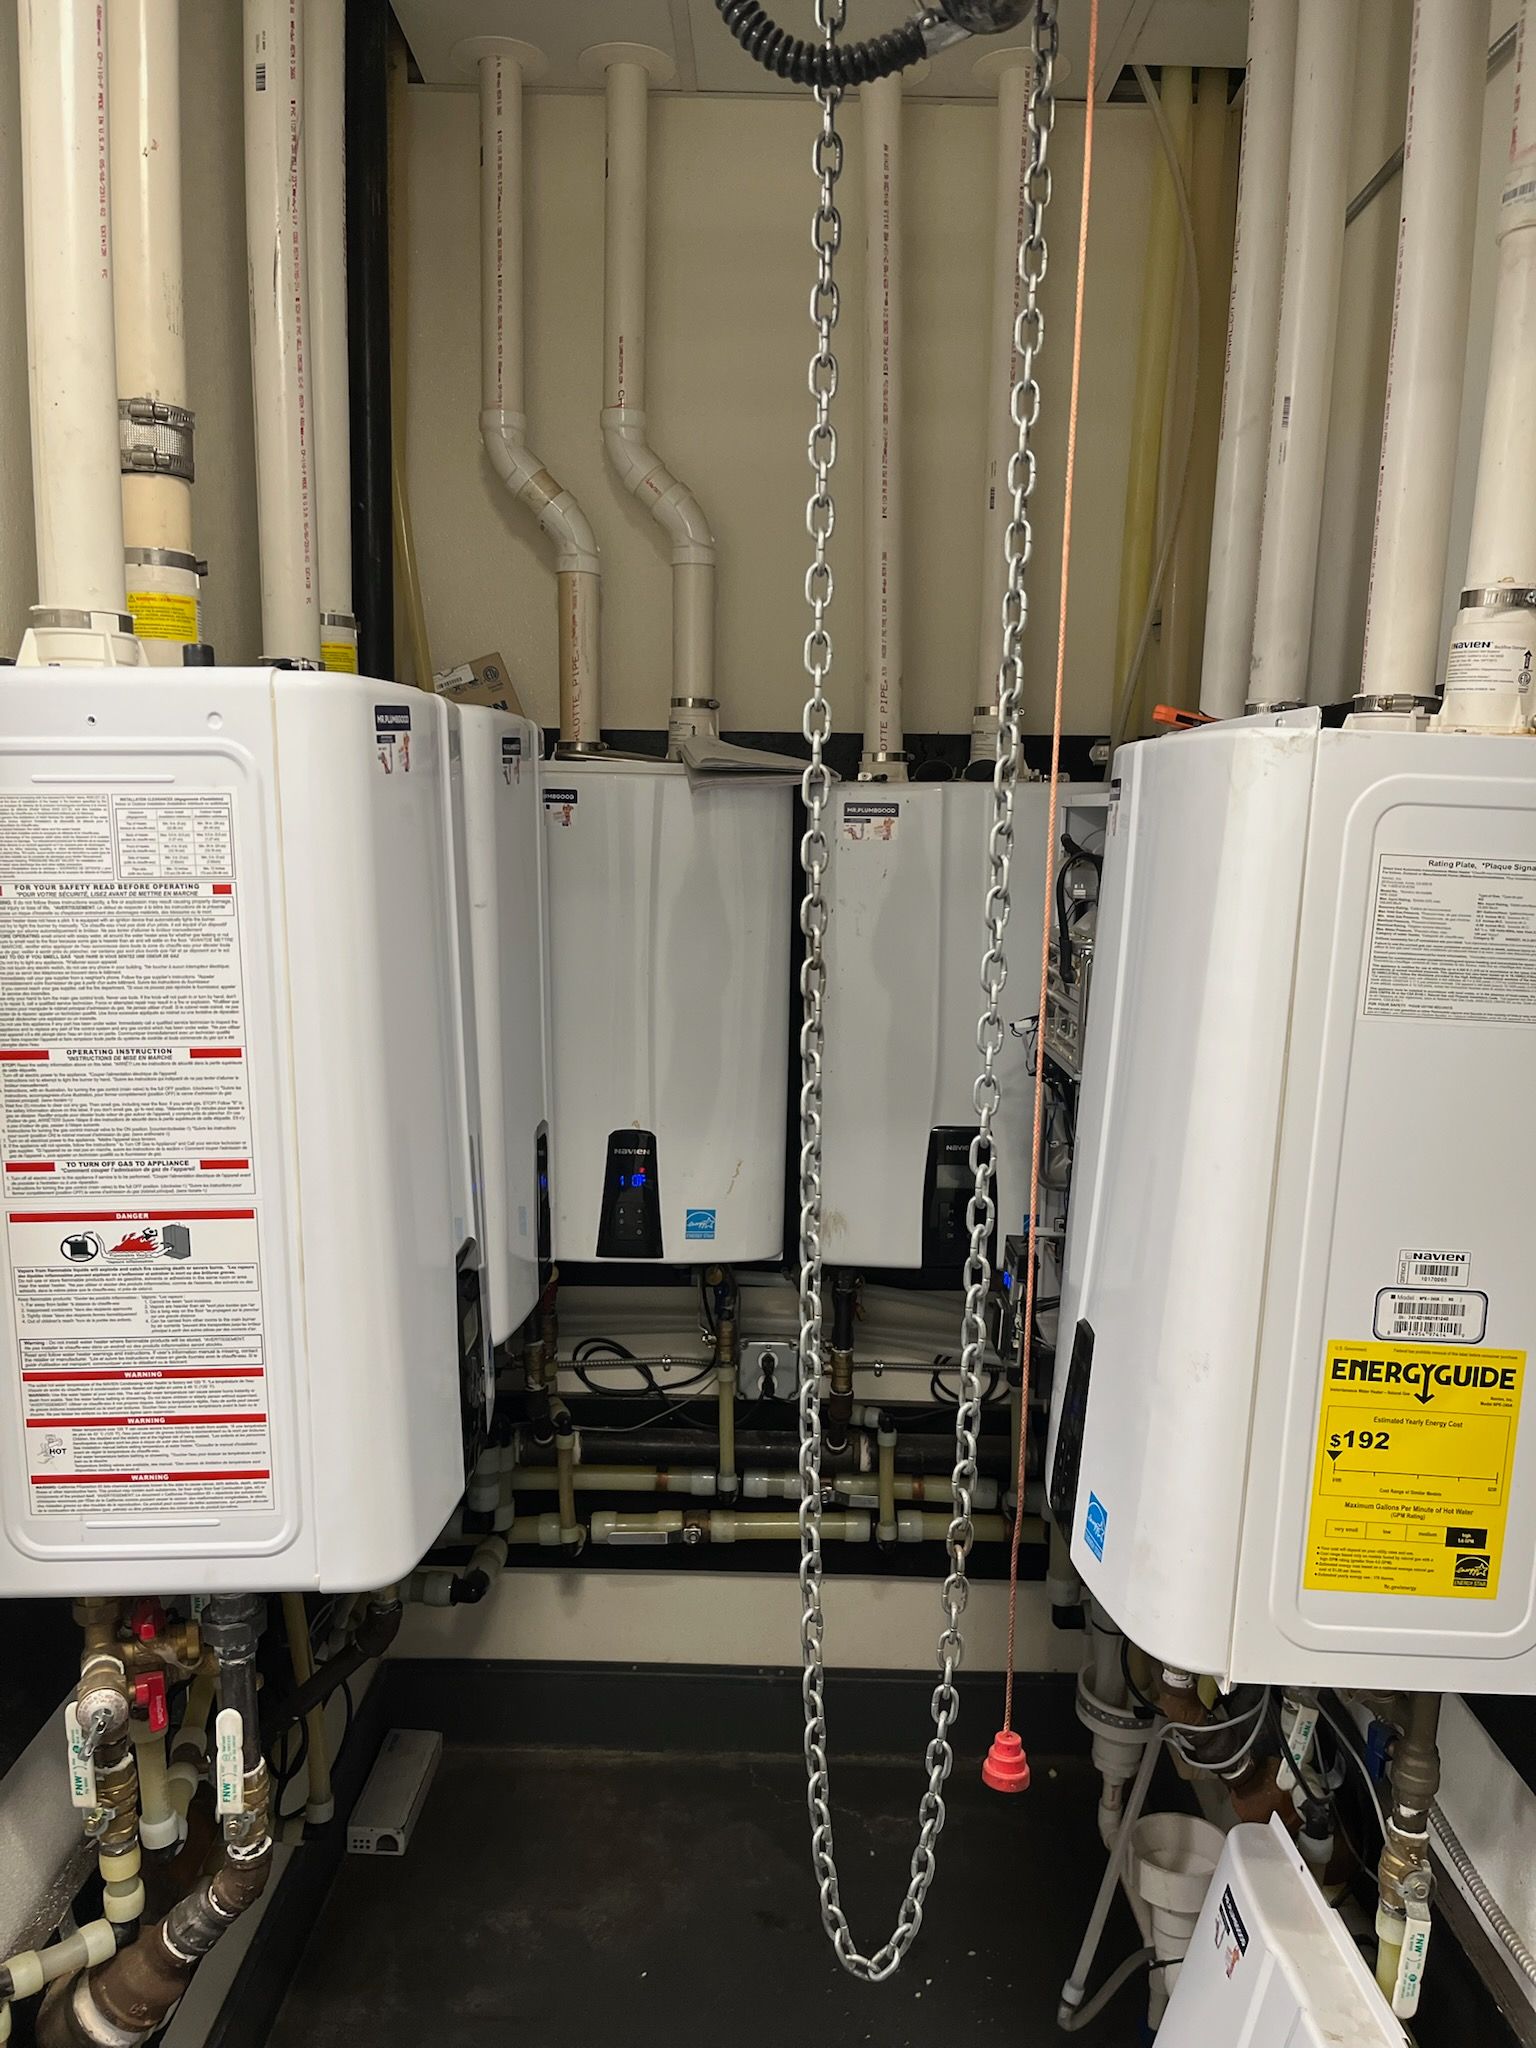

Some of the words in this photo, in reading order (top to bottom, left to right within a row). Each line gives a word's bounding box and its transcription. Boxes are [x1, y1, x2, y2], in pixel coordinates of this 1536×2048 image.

[572, 655, 580, 687] PIPE
[880, 680, 888, 714] PIPE
[1428, 860, 1454, 869] Rating
[1455, 861, 1477, 870] Plate,
[124, 1370, 163, 1379] WARNING
[1331, 1358, 1517, 1393] ENERGYGUIDE
[1373, 1416, 1404, 1426] Estimated
[1405, 1417, 1424, 1428] Yearly
[1425, 1418, 1448, 1429] Energy
[1448, 1420, 1463, 1428] Cost
[1330, 1430, 1390, 1450] $192
[49, 1447, 67, 1456] HOT
[131, 1473, 170, 1482] WARNING
[1344, 1502, 1374, 1510] Maximum
[1376, 1503, 1399, 1511] Gallons
[1400, 1504, 1412, 1512] Per
[1413, 1506, 1434, 1514] Minute
[1435, 1506, 1442, 1514] of
[1456, 1508, 1474, 1516] Water
[1406, 1513, 1426, 1521] Rating)
[75, 1775, 84, 1796] FNW
[223, 1782, 231, 1803] FNW
[1414, 1933, 1425, 1953] FNW
